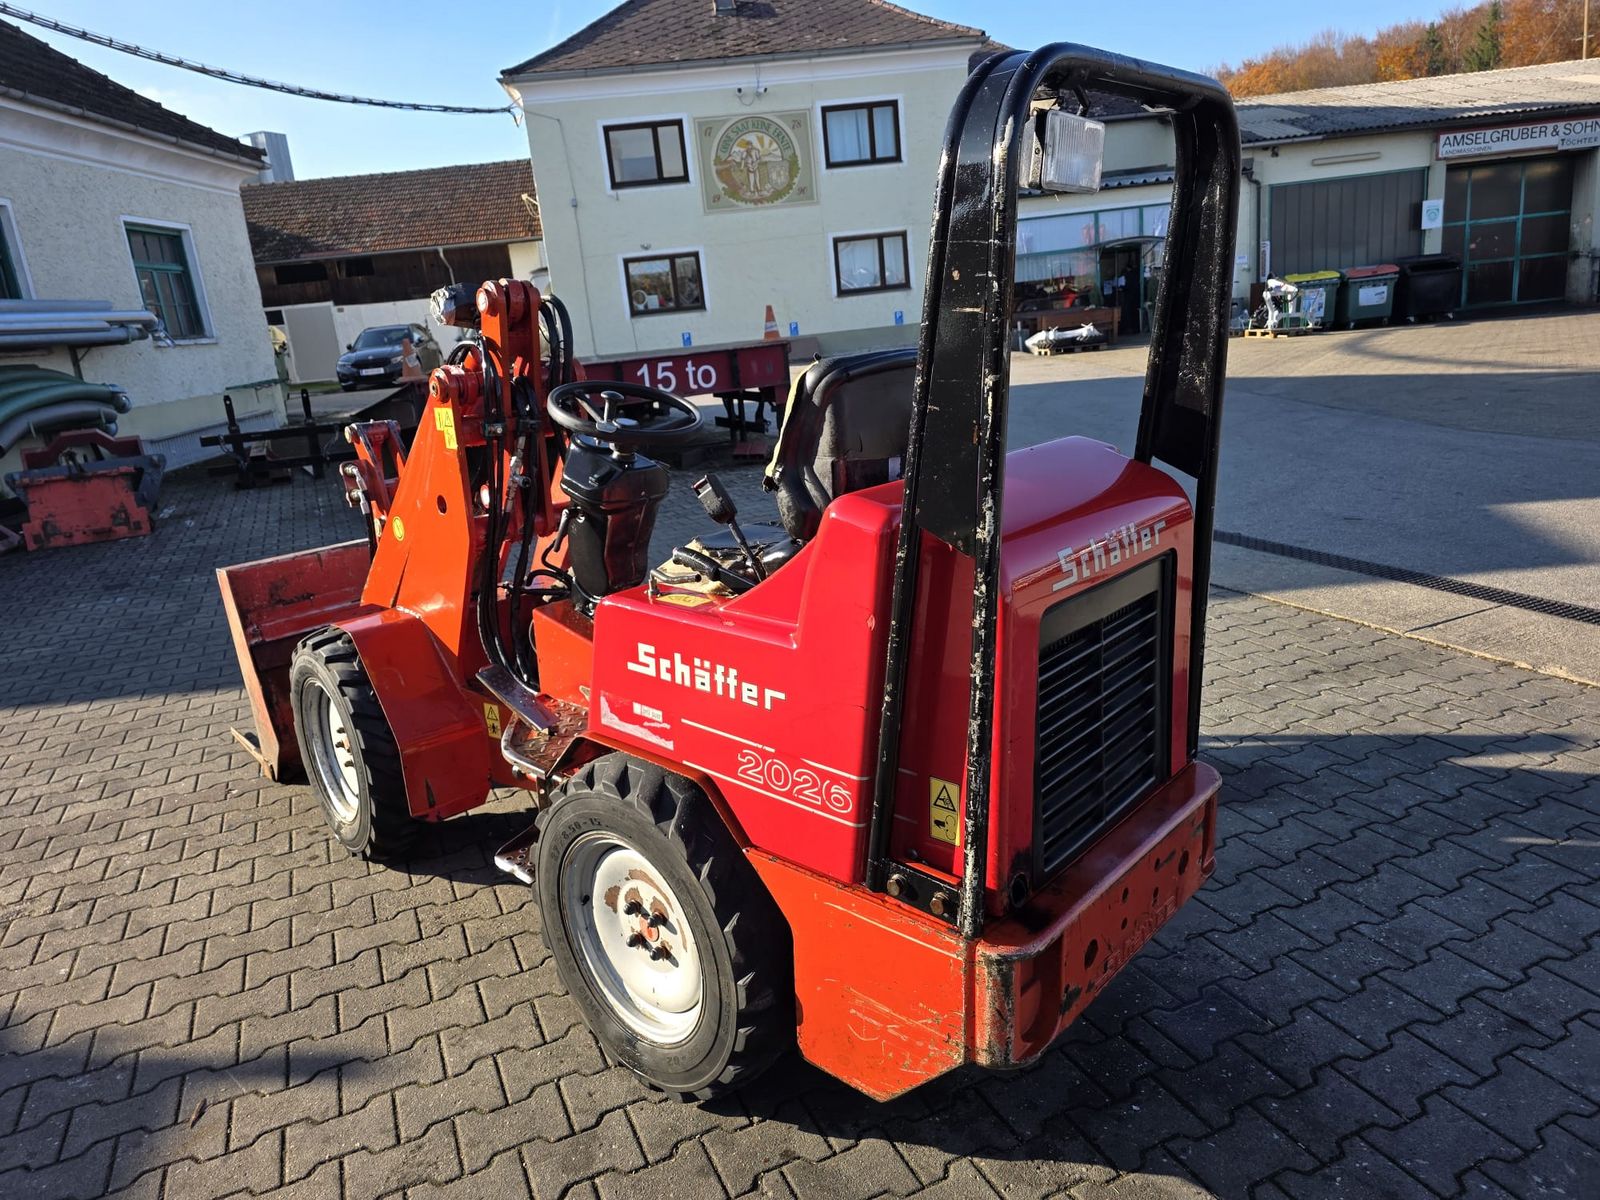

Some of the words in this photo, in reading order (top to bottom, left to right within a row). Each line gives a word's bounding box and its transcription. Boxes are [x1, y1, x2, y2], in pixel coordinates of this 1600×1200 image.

[1442, 125, 1548, 148] AMSELGRUBER
[1550, 124, 1560, 137] &
[636, 361, 677, 393] 15
[685, 359, 717, 389] to
[1052, 520, 1167, 592] Schäffer
[627, 642, 786, 711] Schäffer
[737, 749, 853, 814] 2026
